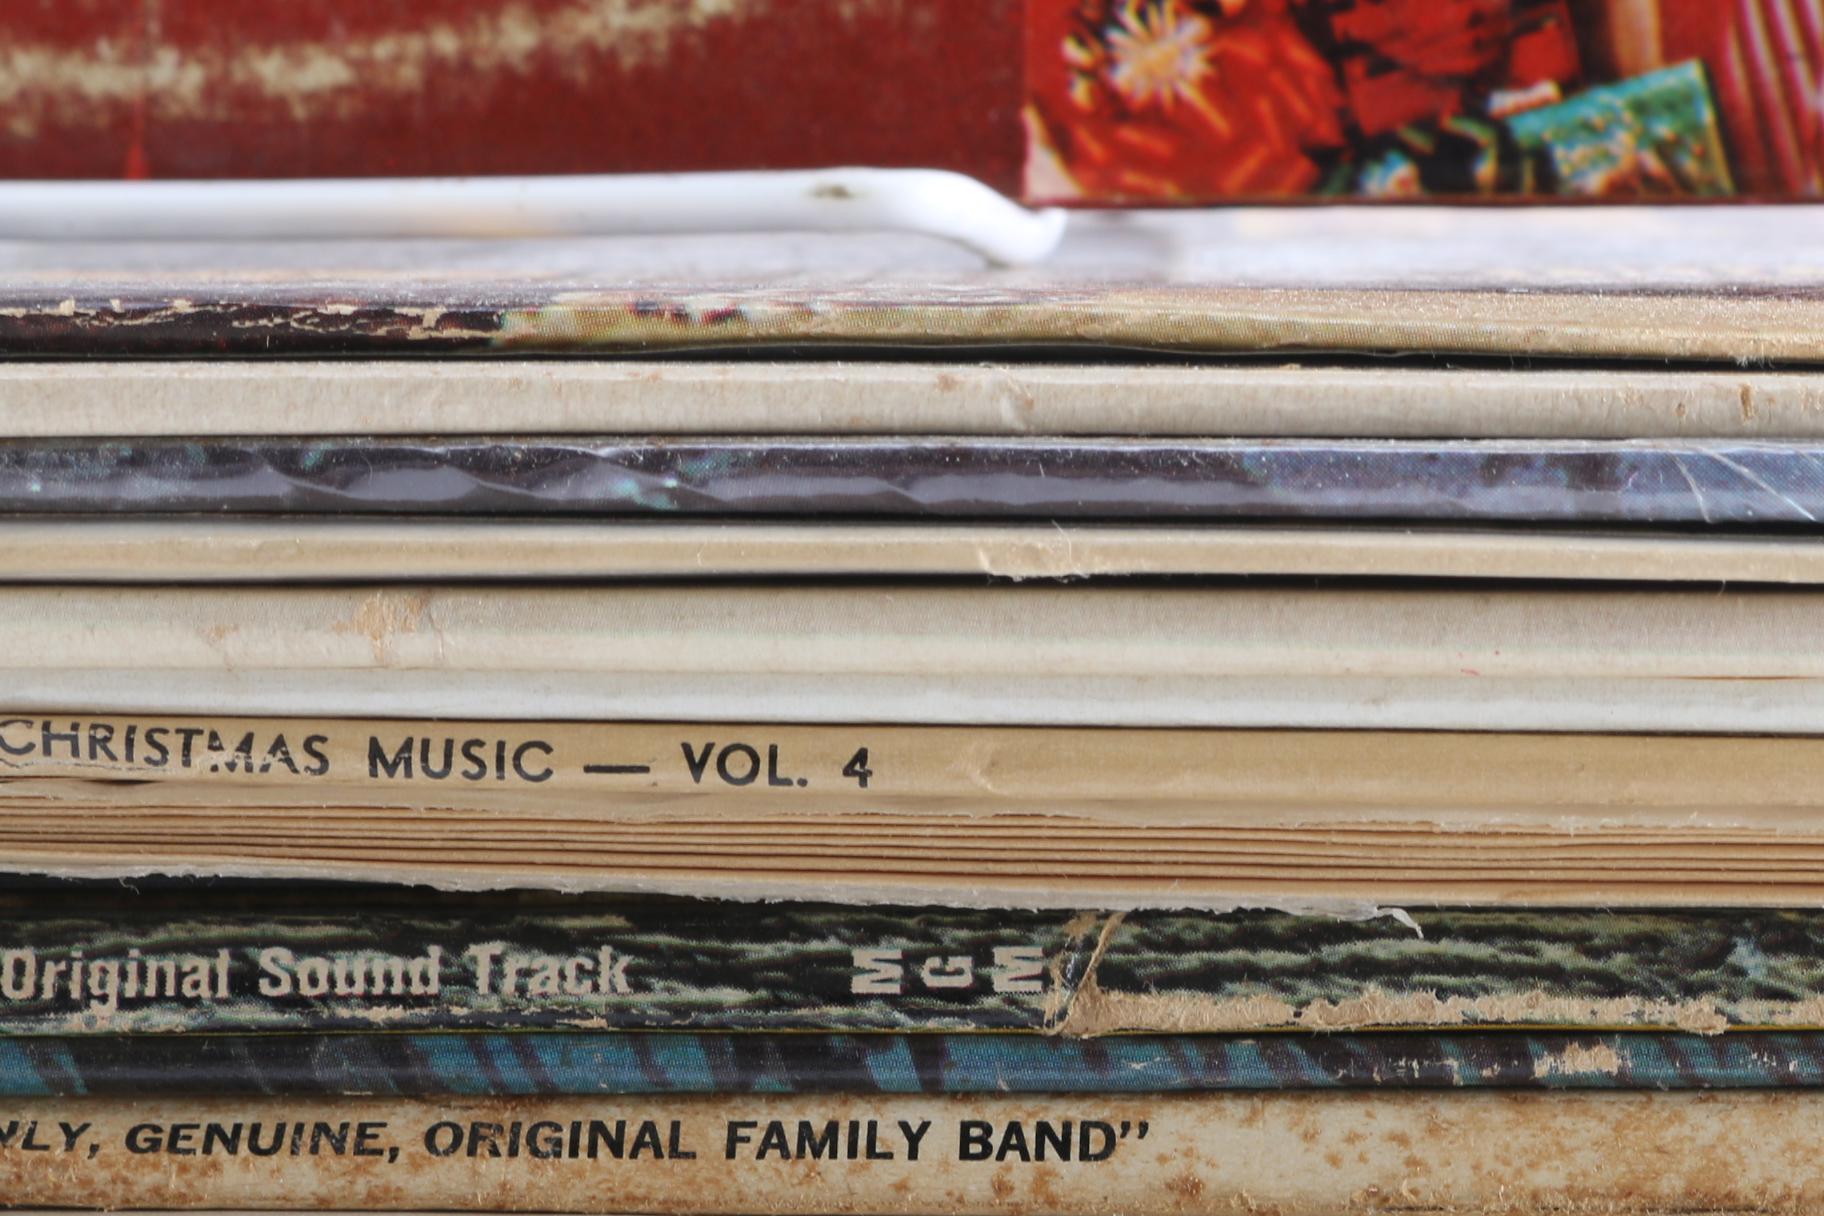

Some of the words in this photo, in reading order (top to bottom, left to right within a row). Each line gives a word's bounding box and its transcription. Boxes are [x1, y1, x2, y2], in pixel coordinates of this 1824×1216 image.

[0, 719, 330, 776] CHRISTMAS
[367, 735, 554, 782] MUSIC
[681, 741, 809, 788] VOL.
[842, 747, 873, 788] 4
[0, 947, 231, 1016] Original
[258, 944, 442, 996] Sound
[464, 941, 635, 995] Track
[125, 1121, 400, 1164] GENUINE,
[424, 1120, 697, 1161] ORIGINAL
[725, 1119, 932, 1161] FAMILY
